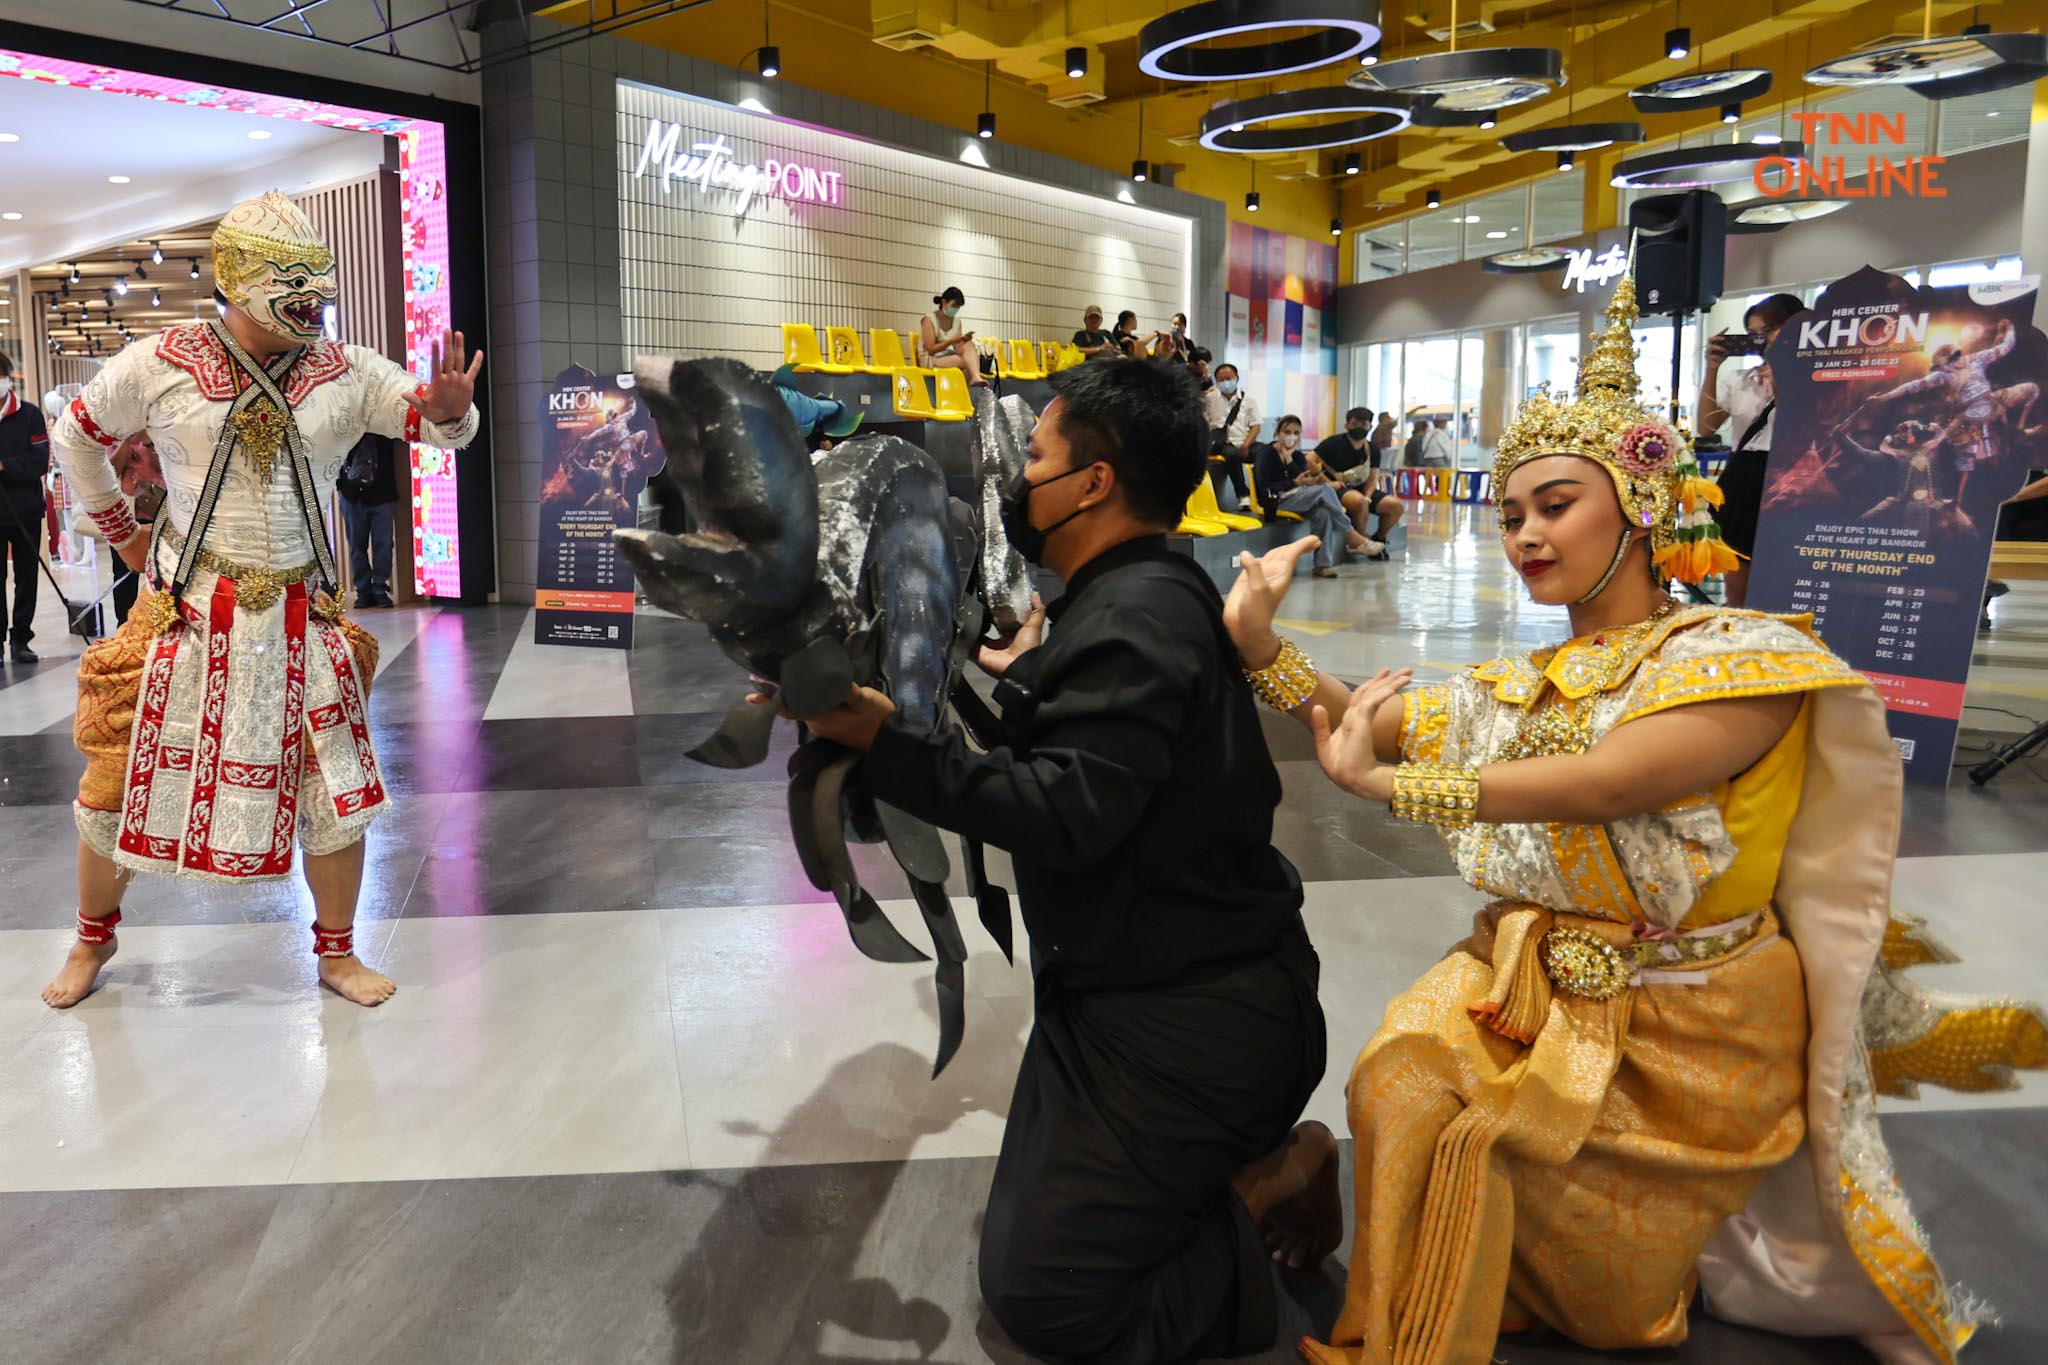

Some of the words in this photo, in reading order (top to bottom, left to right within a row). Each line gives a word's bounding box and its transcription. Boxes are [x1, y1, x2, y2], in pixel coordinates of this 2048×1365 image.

[636, 119, 762, 215] Meeting
[765, 159, 841, 204] POINT
[1978, 285, 2002, 293] MBK
[1832, 307, 1854, 317] MBK
[1857, 304, 1899, 315] CENTER
[1798, 313, 1929, 350] KHON
[1796, 350, 1813, 358] EPIC
[1814, 348, 1831, 357] THAI
[1833, 347, 1864, 356] MASKED
[1824, 360, 1840, 368] JAN
[1841, 359, 1851, 367] 23
[1871, 358, 1887, 366] DEC
[1888, 358, 1899, 366] 23
[1821, 370, 1841, 378] FREE
[1842, 369, 1886, 377] ADMISSION
[549, 391, 604, 411] KHON
[1815, 525, 1843, 533] ENJOY
[1844, 526, 1865, 534] EPIC
[1867, 527, 1888, 535] THAI
[1890, 528, 1920, 537] SHOW
[1804, 534, 1816, 542] AT
[1817, 535, 1834, 543] THE
[1835, 536, 1865, 545] HEART
[1866, 538, 1879, 546] OF
[1880, 539, 1926, 548] BANGKOK
[1839, 549, 1904, 562] THURSDAY
[1907, 553, 1936, 565] END
[1812, 560, 1829, 570] OF
[1830, 561, 1855, 573] THE
[1794, 579, 1811, 587] JAN
[1820, 581, 1831, 589] 26
[1793, 591, 1812, 599] MAR
[1818, 593, 1828, 601] 30
[1886, 586, 1904, 595] FEB
[1913, 589, 1925, 597] 23
[1791, 603, 1808, 611] MAY
[1816, 605, 1826, 613] 25
[1884, 599, 1903, 608] APR
[1911, 601, 1923, 609] 27
[1814, 617, 1824, 625] 27
[1881, 612, 1900, 621] JUN
[1880, 625, 1898, 634] AUG
[1906, 627, 1917, 635] 31
[1878, 637, 1895, 645] OCT
[1904, 640, 1915, 648] 26
[1875, 650, 1893, 658] DEC
[1902, 653, 1913, 661] 28
